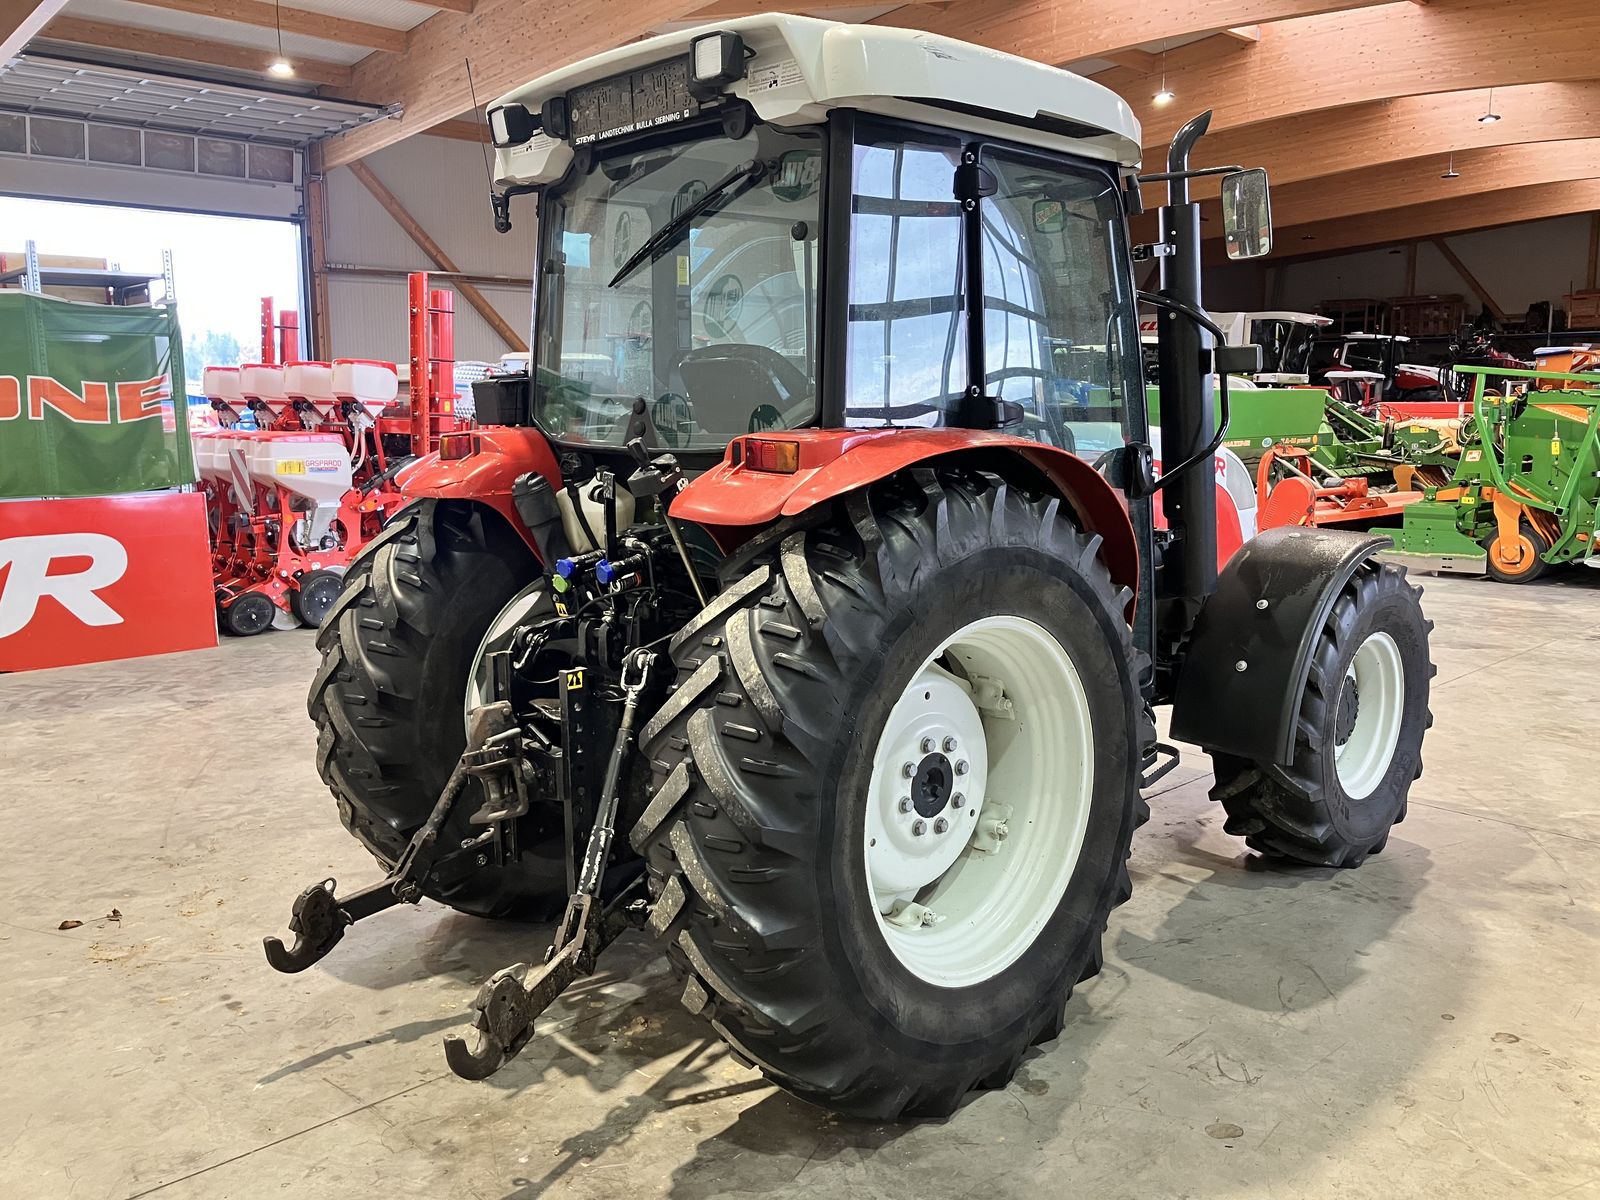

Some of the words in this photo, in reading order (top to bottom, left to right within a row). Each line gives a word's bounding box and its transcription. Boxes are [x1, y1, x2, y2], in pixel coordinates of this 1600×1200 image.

[575, 134, 596, 145] STEYR
[599, 124, 635, 140] LANDTECHNIK
[636, 119, 653, 130] BULLA
[654, 111, 681, 126] SIERNING
[305, 459, 342, 468] GASPARDO
